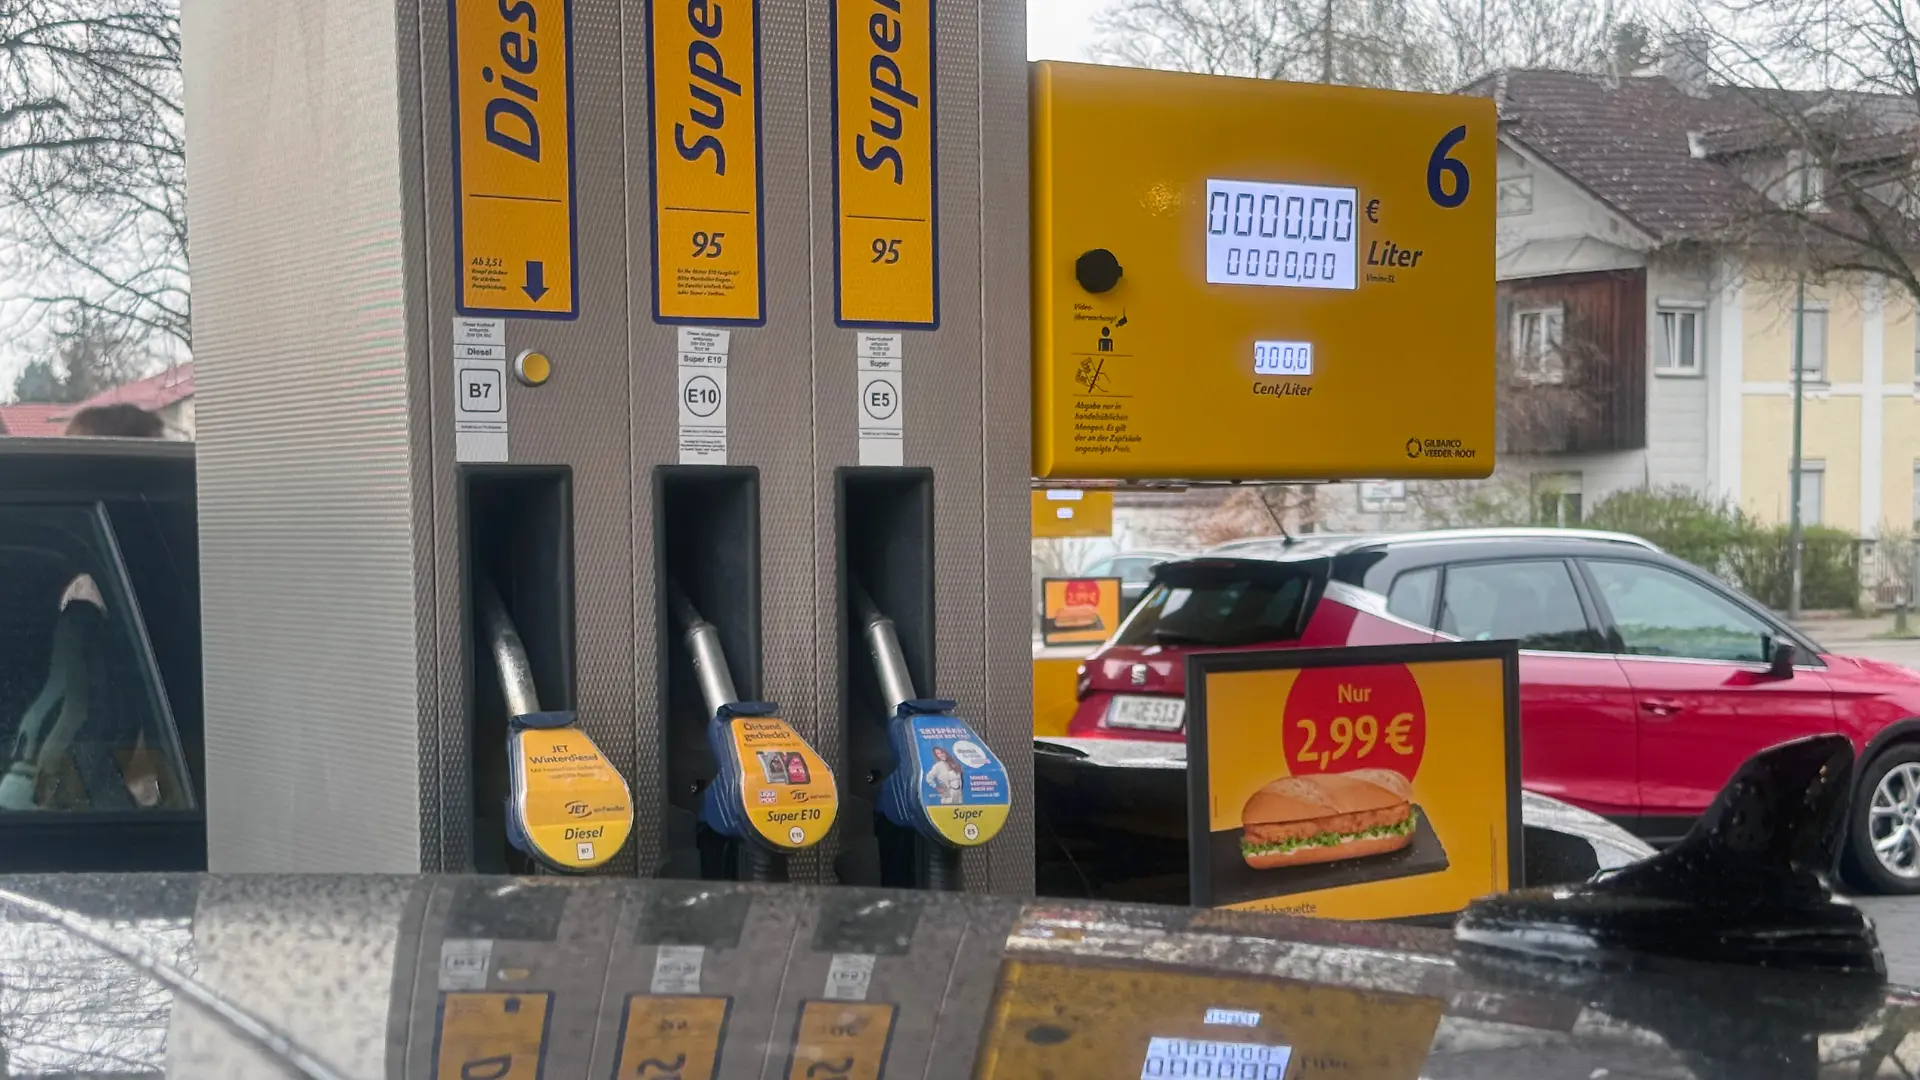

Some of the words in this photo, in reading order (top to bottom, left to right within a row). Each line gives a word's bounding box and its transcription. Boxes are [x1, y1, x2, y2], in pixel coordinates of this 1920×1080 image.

[1427, 125, 1470, 208] 6
[1208, 191, 1353, 243] 0000,00
[1365, 199, 1380, 223] €
[692, 231, 725, 258] 95
[871, 238, 903, 264] 95
[1367, 240, 1423, 267] Liter
[472, 257, 484, 266] Ab
[1227, 248, 1336, 282] 0000,00
[467, 348, 492, 356] Diesel
[684, 355, 705, 365] Super
[707, 356, 722, 364] E10
[870, 360, 890, 369] Super
[469, 383, 492, 398] B7
[688, 389, 717, 403] E10
[1253, 382, 1313, 398] Cent/Liter
[871, 392, 890, 407] E5
[1424, 439, 1461, 448] GILBARCO
[1424, 449, 1476, 458] VEEDER-ROOT
[1338, 684, 1372, 703] Nur
[552, 745, 568, 753] JET
[530, 753, 598, 764] Winterdiesel
[792, 791, 807, 801] JET
[567, 804, 588, 814] JET
[953, 808, 983, 822] Super
[767, 811, 799, 824] Super
[801, 809, 821, 821] E10
[564, 826, 604, 840] Diesel
